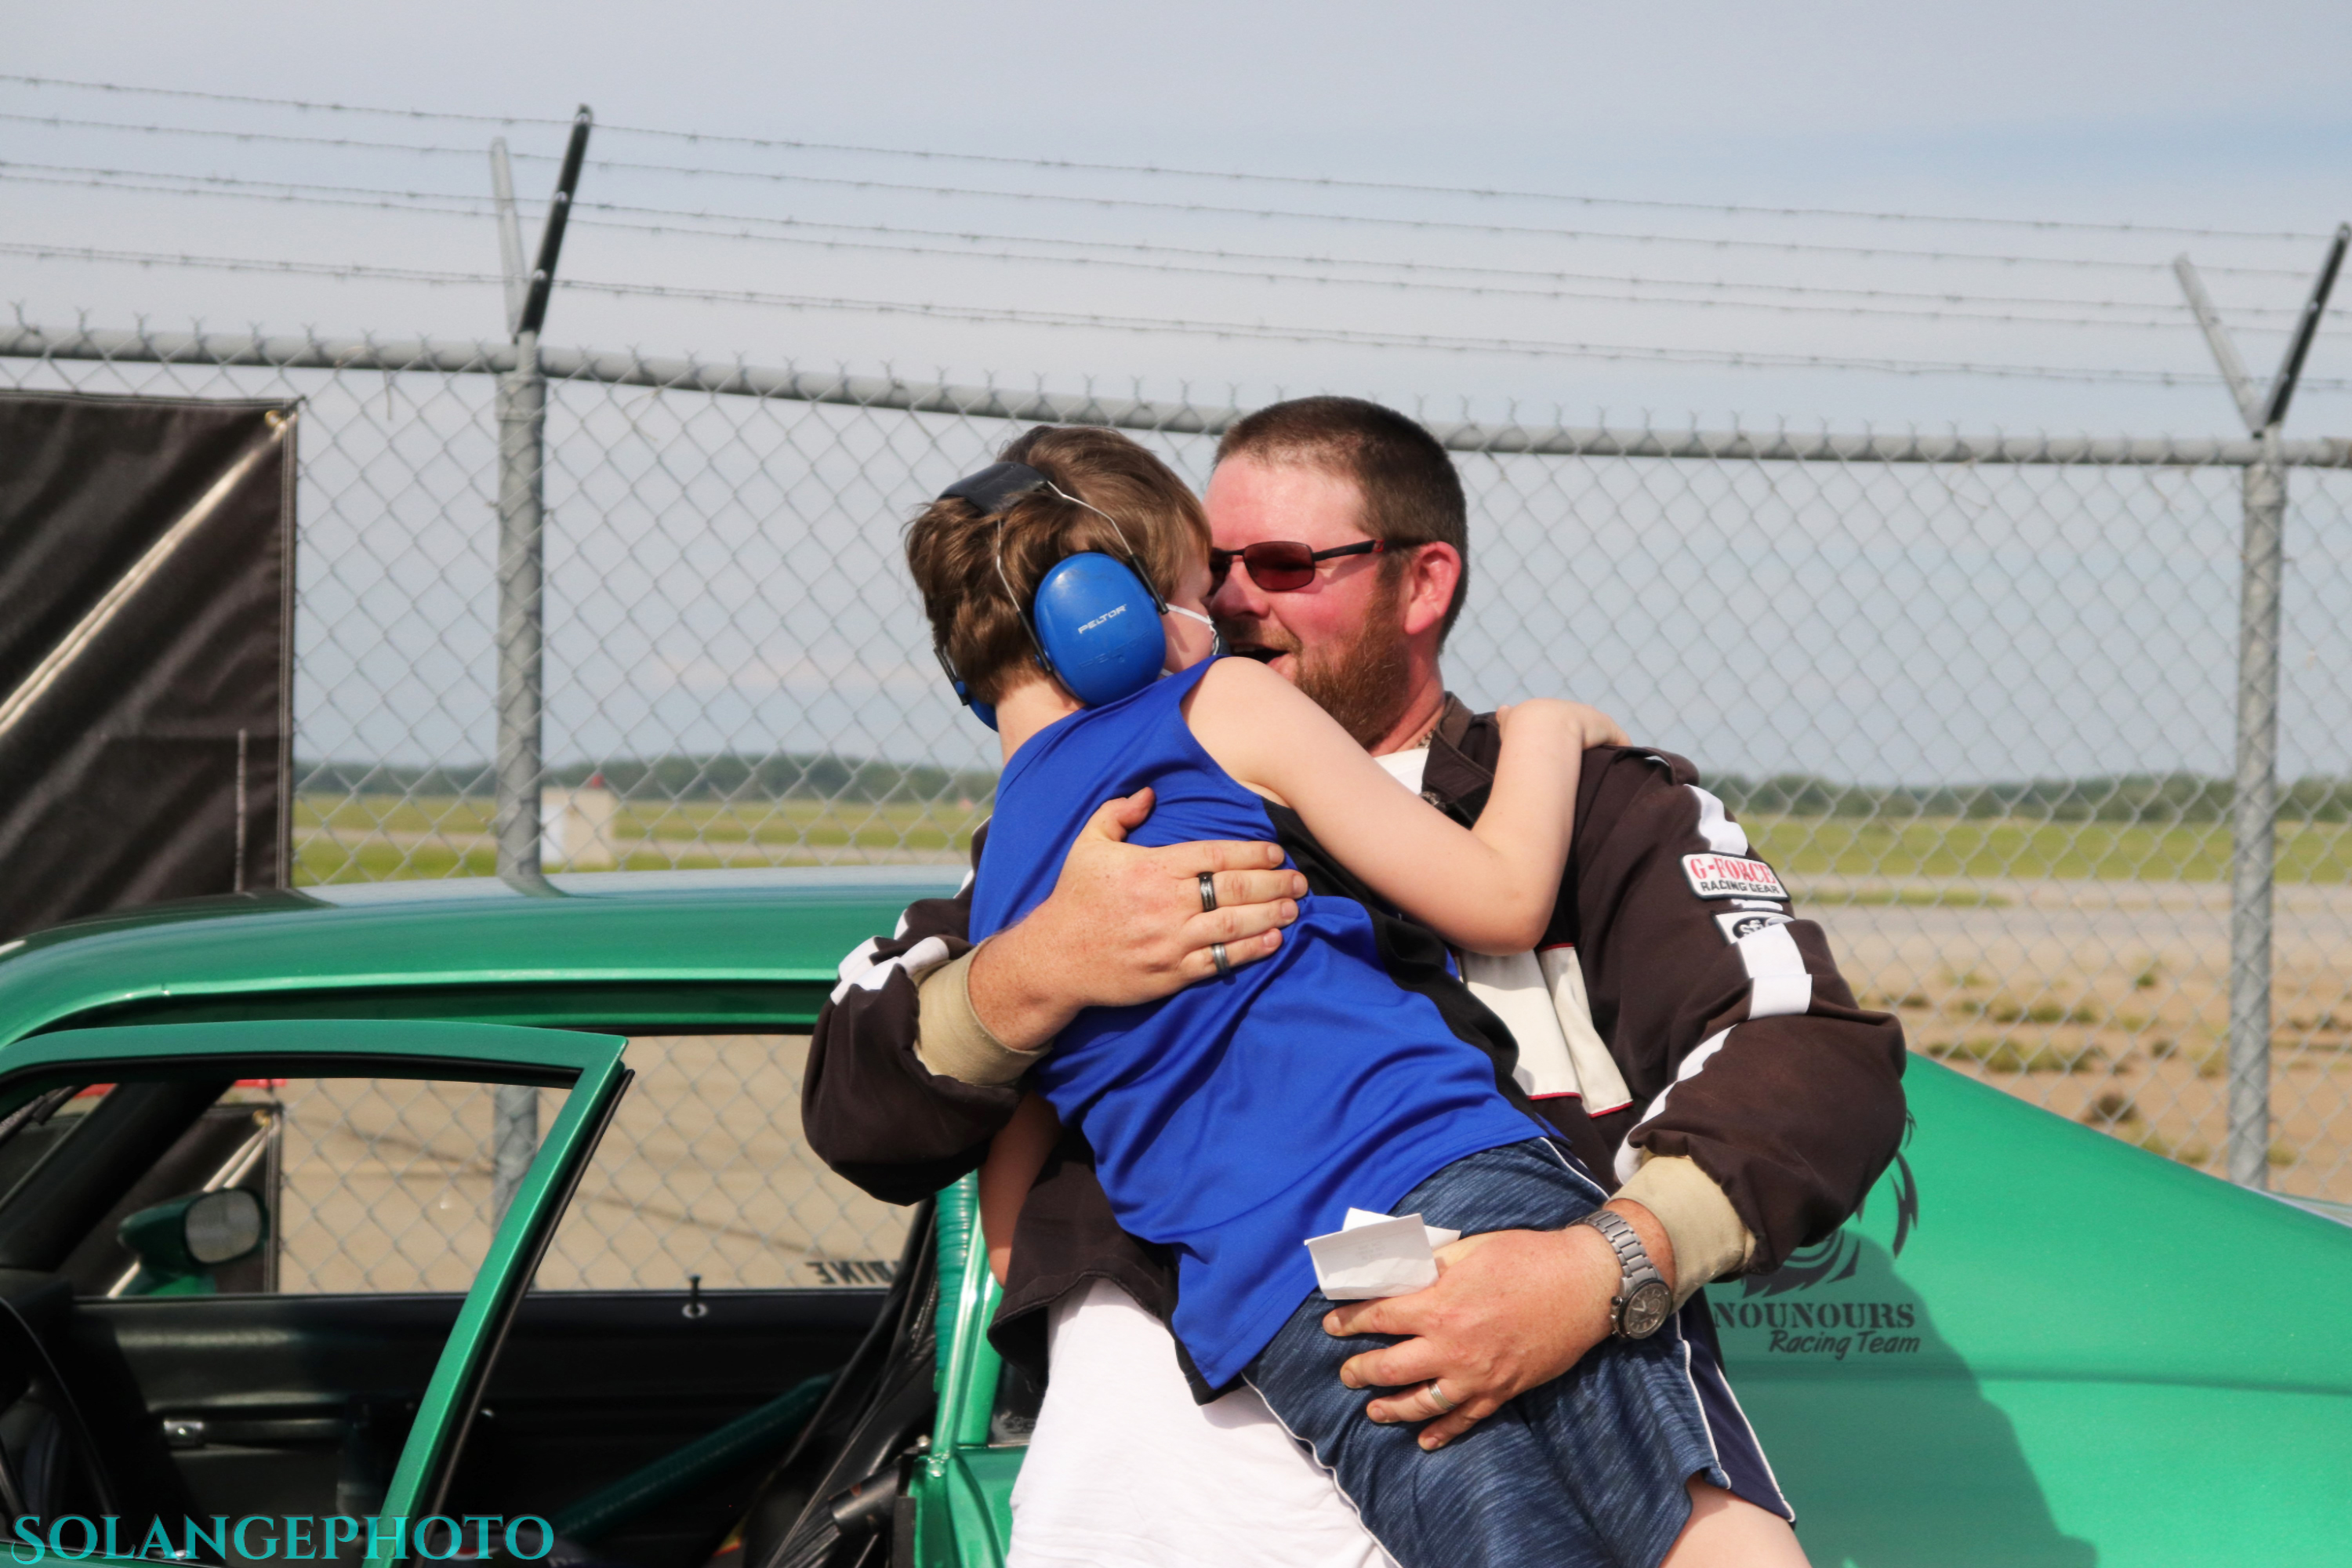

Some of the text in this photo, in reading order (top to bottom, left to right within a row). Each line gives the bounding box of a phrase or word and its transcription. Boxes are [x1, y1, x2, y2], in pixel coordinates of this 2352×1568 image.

[1077, 604, 1127, 633] PELTOR
[1690, 857, 1777, 884] G-FORCE
[1700, 880, 1780, 894] RACING GEAR
[1713, 1302, 1915, 1329] NOUNOURS
[1768, 1330, 1921, 1361] Racing Team
